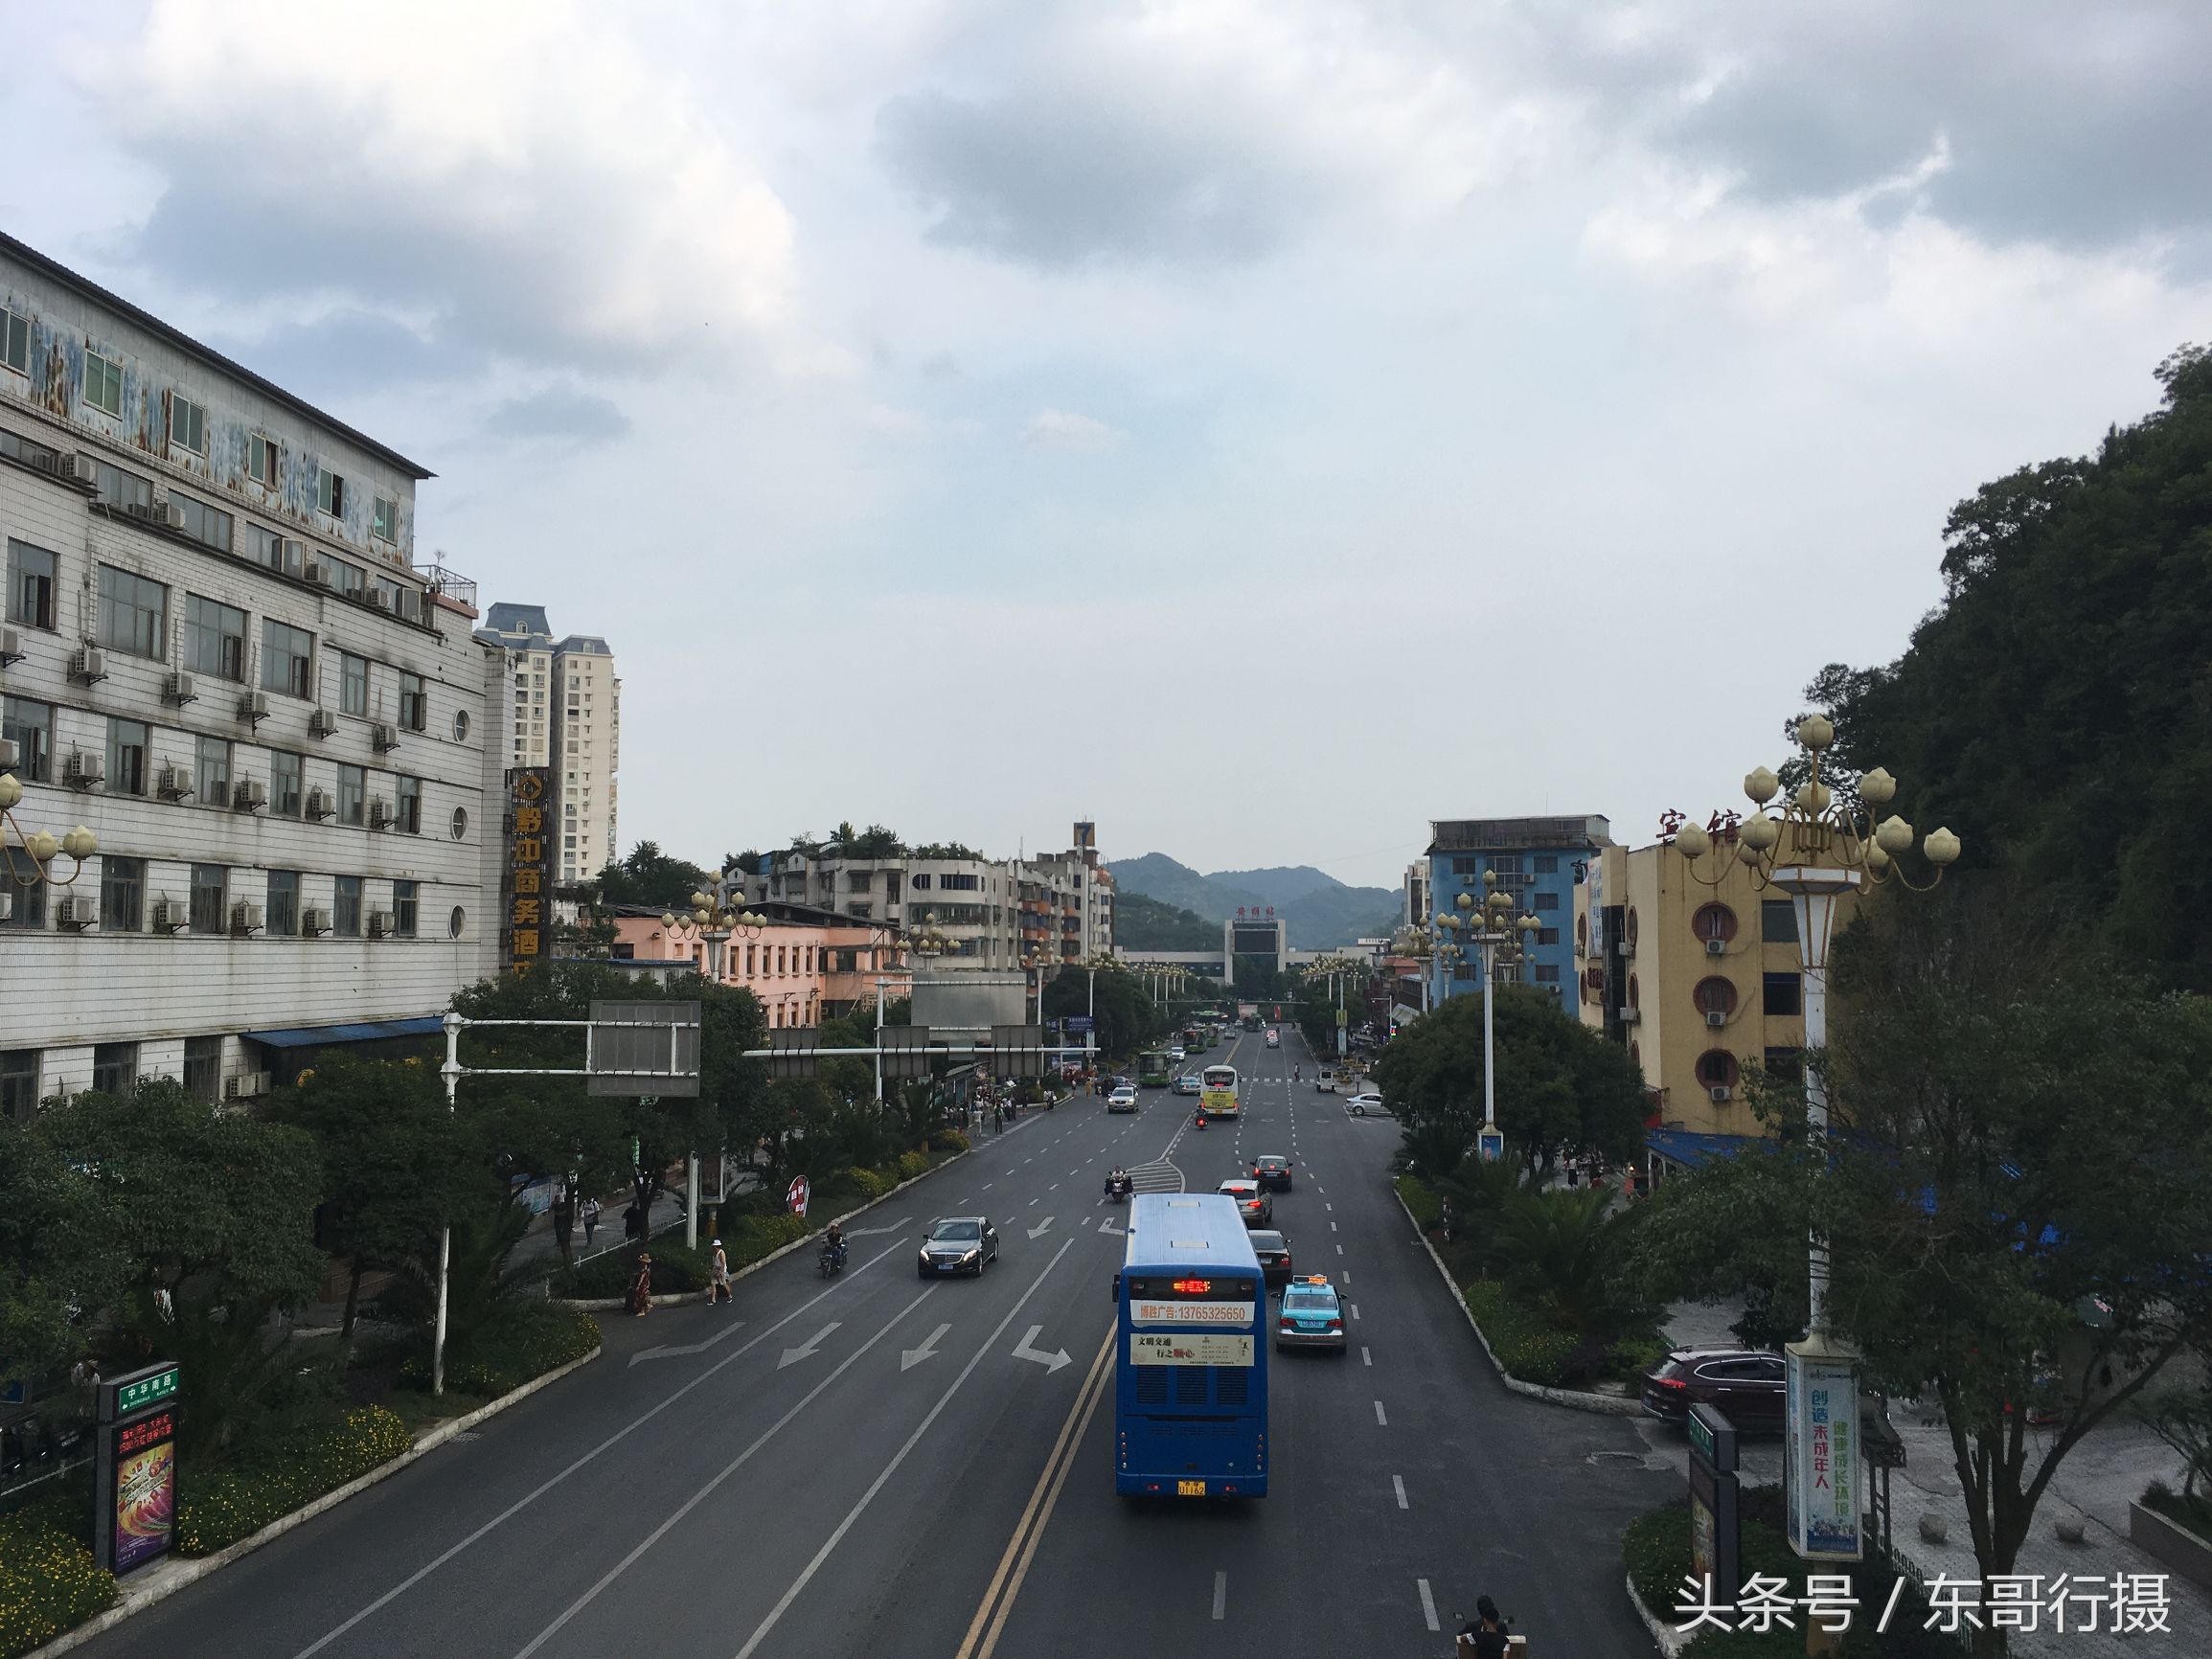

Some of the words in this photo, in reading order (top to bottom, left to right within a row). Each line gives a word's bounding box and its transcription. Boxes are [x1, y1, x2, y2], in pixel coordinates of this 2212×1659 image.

[1076, 823, 1091, 844] 7
[1655, 808, 1742, 843] 宾馆
[127, 1375, 171, 1399] 中华南路
[1812, 1389, 1829, 1489] 创造未成年人
[1834, 1420, 1849, 1517] 健康成长环境
